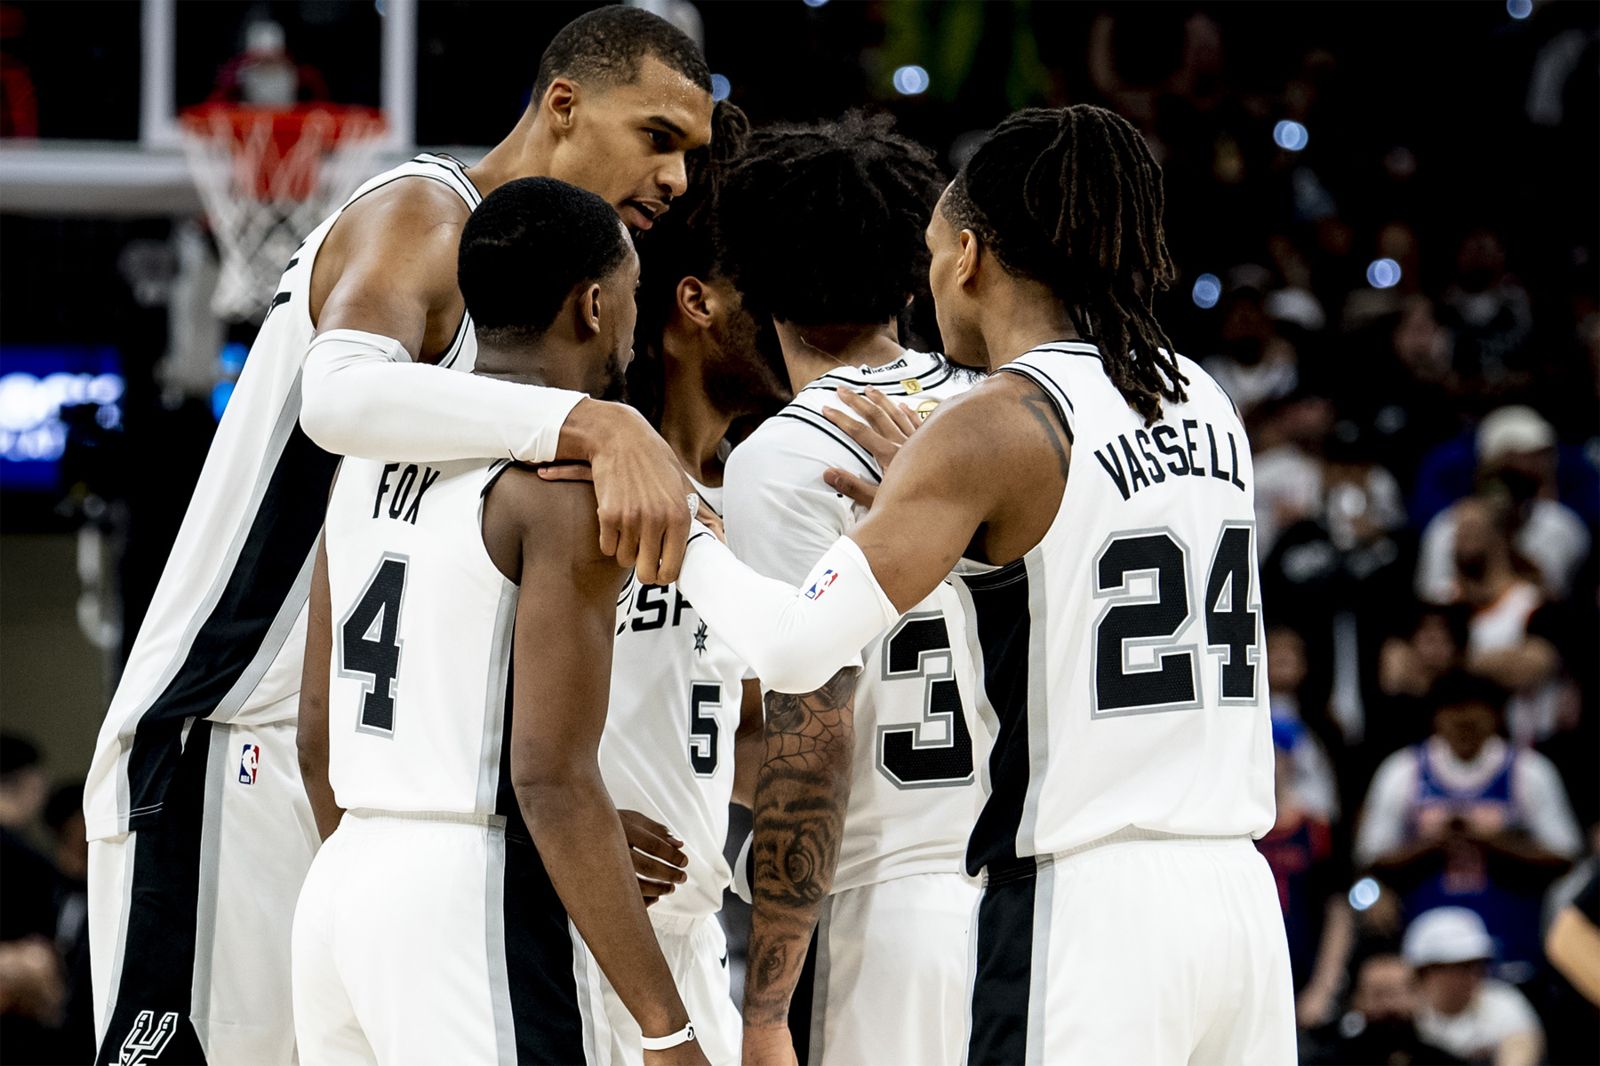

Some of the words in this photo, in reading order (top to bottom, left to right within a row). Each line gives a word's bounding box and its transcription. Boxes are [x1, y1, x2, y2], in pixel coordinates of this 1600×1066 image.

[372, 463, 441, 525] FOX
[1094, 419, 1246, 501] VASSELL
[337, 551, 410, 740] 4
[1090, 519, 1262, 719] 24
[688, 680, 723, 778] 5
[876, 610, 976, 789] 3
